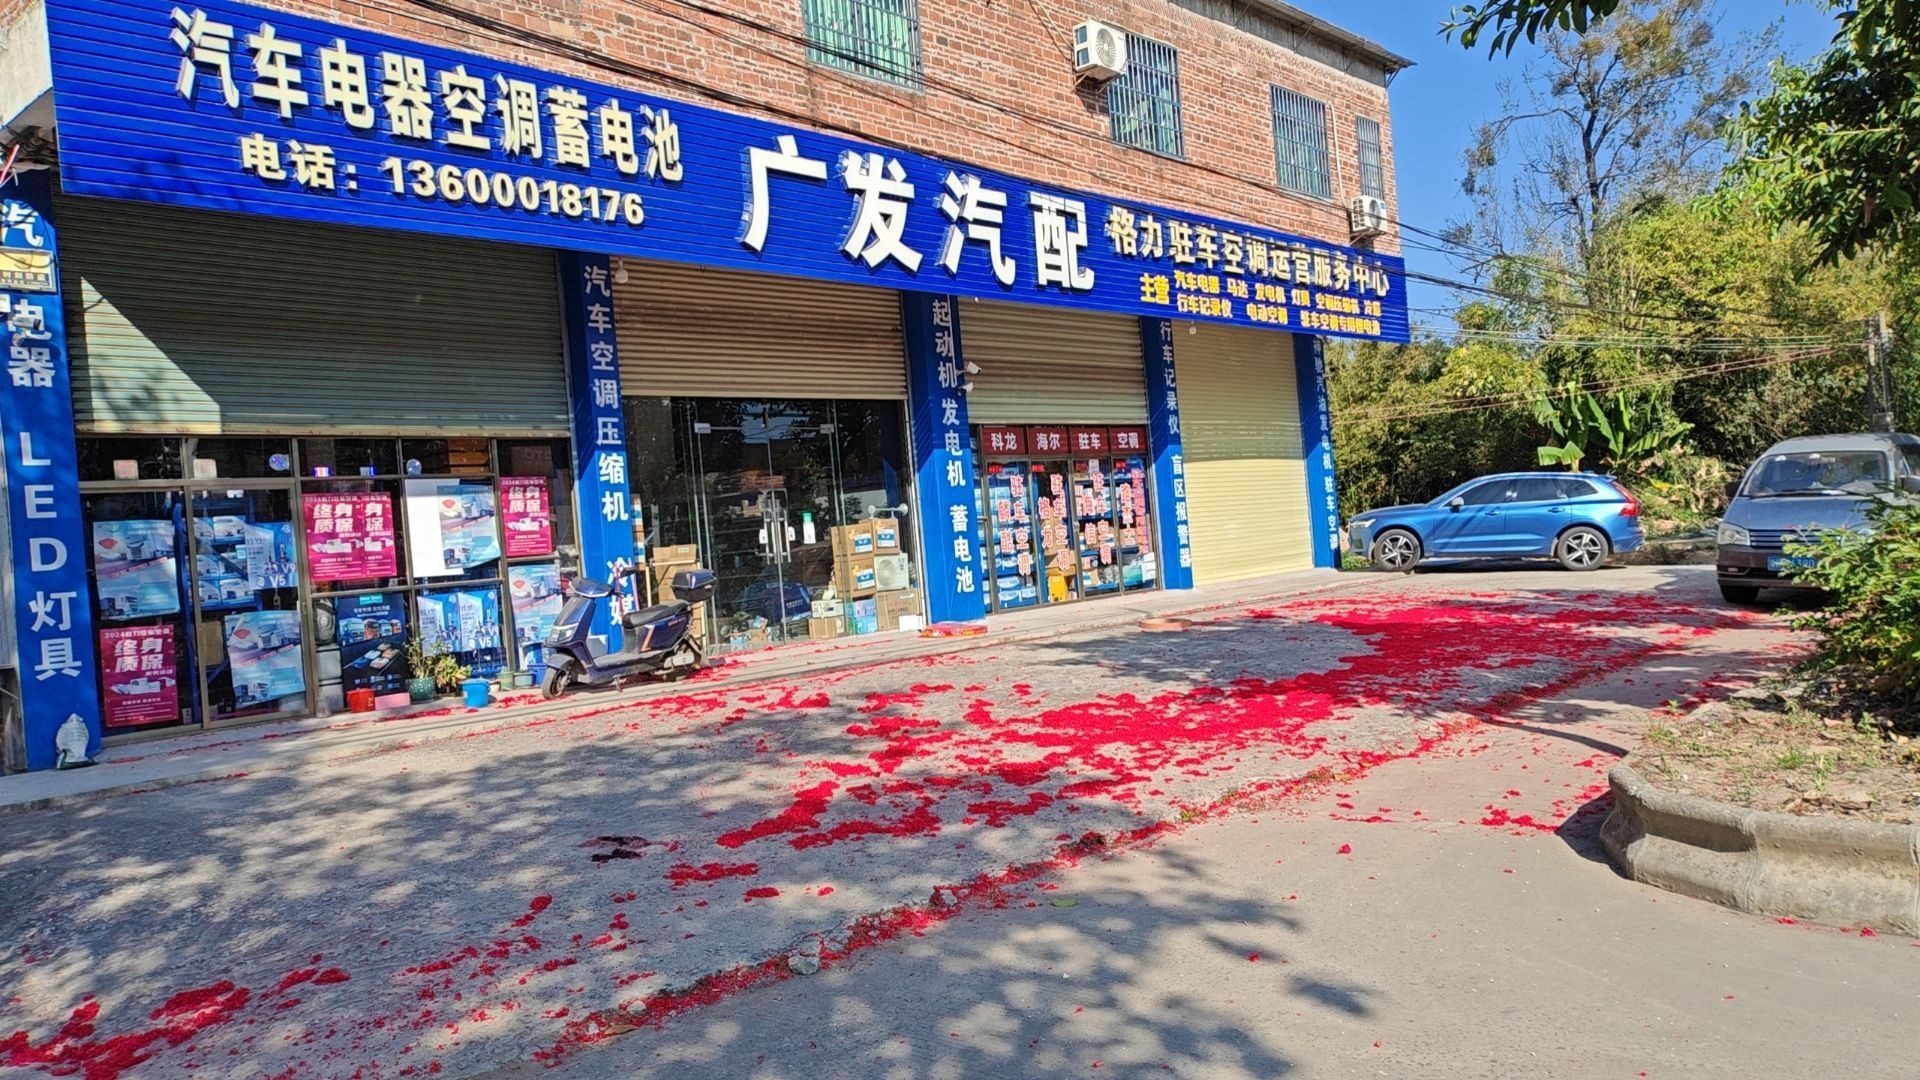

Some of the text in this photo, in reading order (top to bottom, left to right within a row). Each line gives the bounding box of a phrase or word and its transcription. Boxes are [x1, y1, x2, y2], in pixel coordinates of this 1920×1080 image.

[169, 7, 684, 182] 汽车电器空调蓄电池
[740, 135, 1095, 291] 广发汽配
[1106, 205, 1390, 297] 格力驻车空调运营服务中心
[1140, 272, 1169, 305] 主营
[1174, 269, 1220, 294] 汽车电器
[1227, 278, 1249, 298] 马达
[1255, 283, 1286, 304] 发电机
[1177, 293, 1233, 318] 行车记录仪
[1246, 303, 1288, 325] 电动空调
[584, 265, 629, 522] 汽车空调压缩机
[991, 432, 1017, 451] 科龙
[1036, 432, 1061, 451] 海尔
[1078, 432, 1101, 450] 驻车
[1117, 431, 1139, 449] 空调
[1160, 321, 1191, 569] 行车记录仪 盲区报警器
[314, 517, 354, 533] 质保
[1050, 473, 1070, 571] 驻车空调
[950, 504, 975, 593] 蓄电池
[269, 574, 286, 588] V5
[114, 637, 163, 656] 终身
[114, 653, 164, 673] 质保
